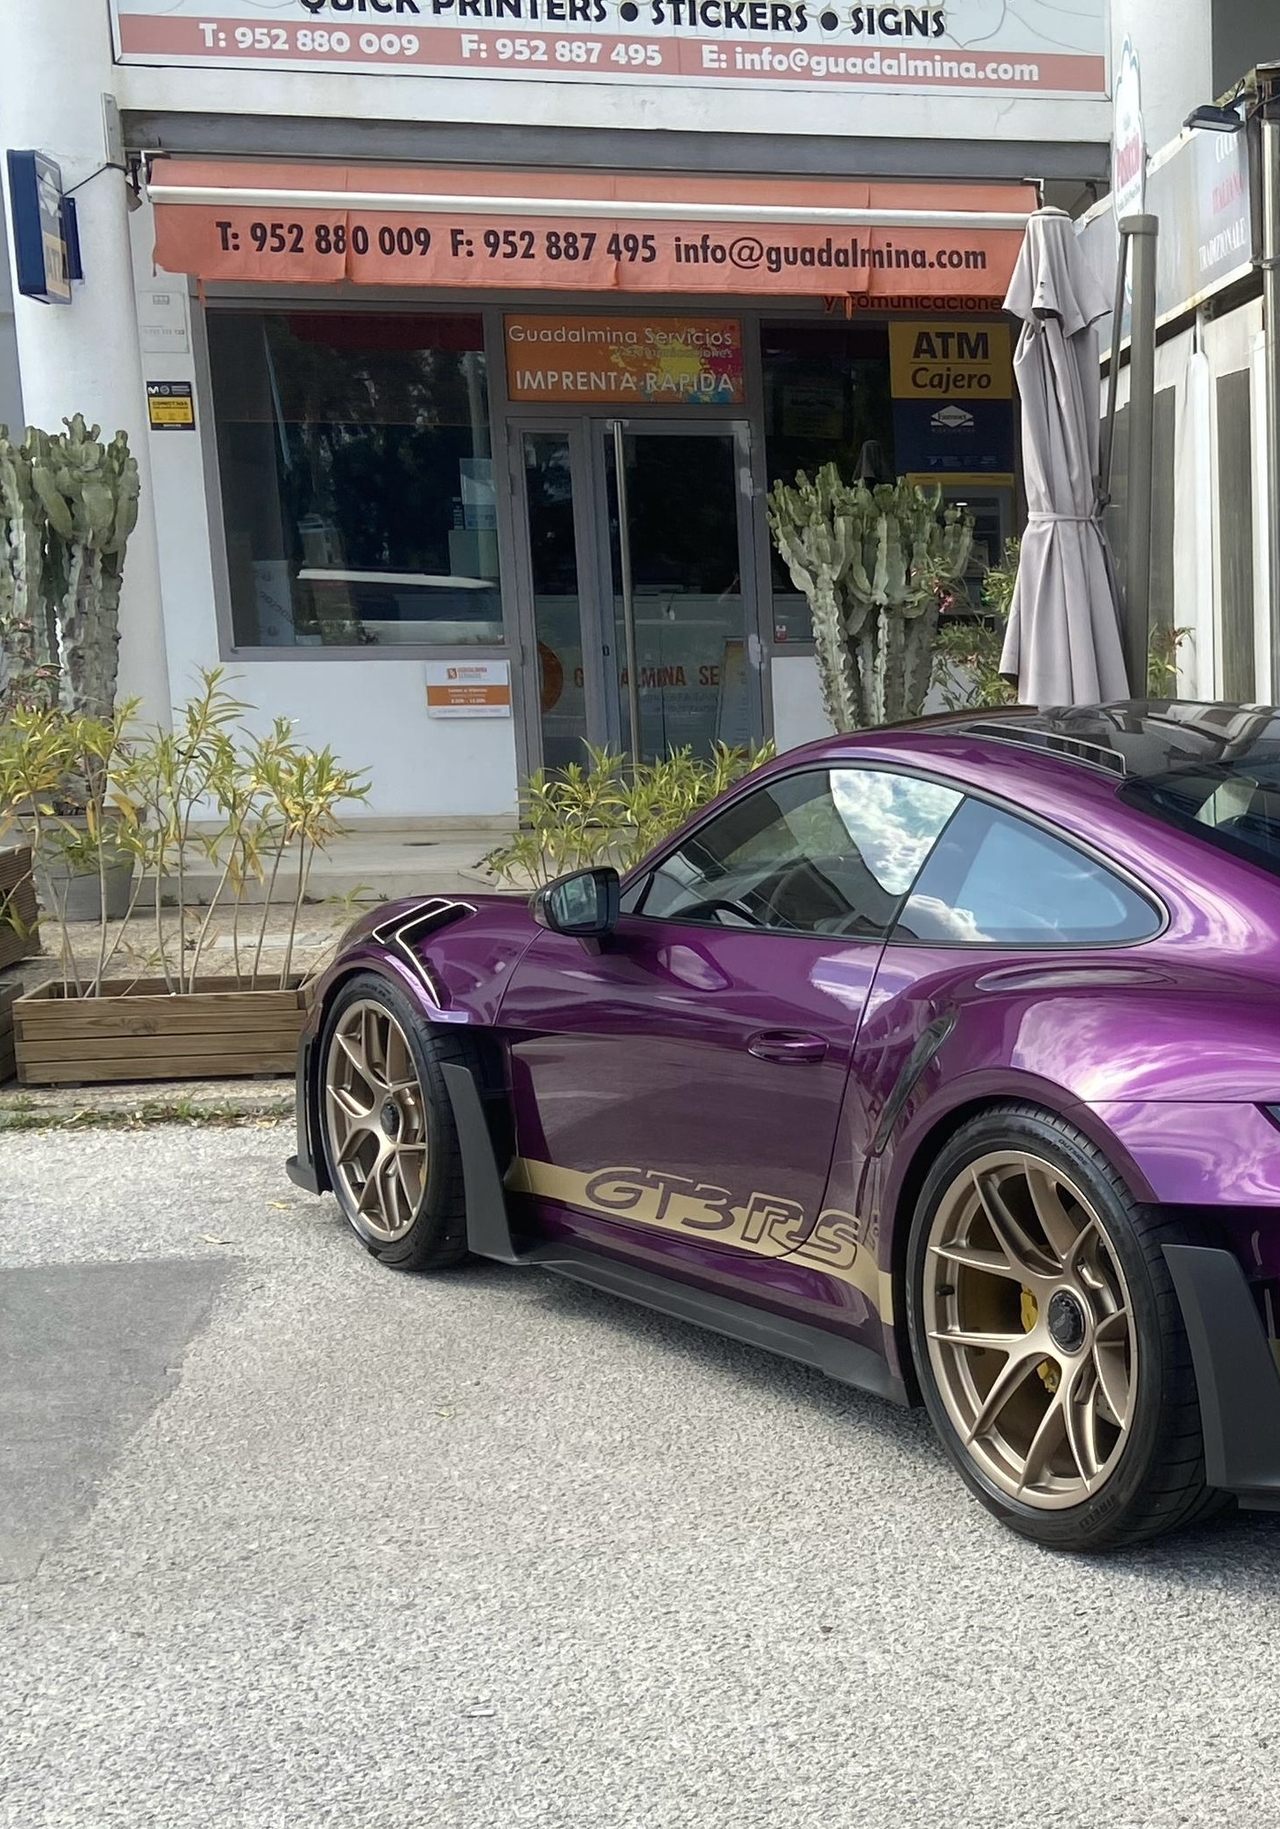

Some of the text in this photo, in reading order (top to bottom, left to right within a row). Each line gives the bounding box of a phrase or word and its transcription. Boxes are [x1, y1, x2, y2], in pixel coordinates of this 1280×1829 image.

[651, 0, 808, 32] STICKERS
[851, 7, 945, 37] SIGNS
[199, 23, 1039, 82] T: 952 880 009 F: 952 887 495 E: info@guadalmina.com
[215, 221, 987, 274] T: 952 880 009 F: 952 887 495 info@guadalmina.com
[508, 326, 733, 345] Guadalmina Servicios
[912, 331, 989, 360] ATM
[516, 371, 637, 391] IMPRENTA
[911, 367, 992, 394] Cajero
